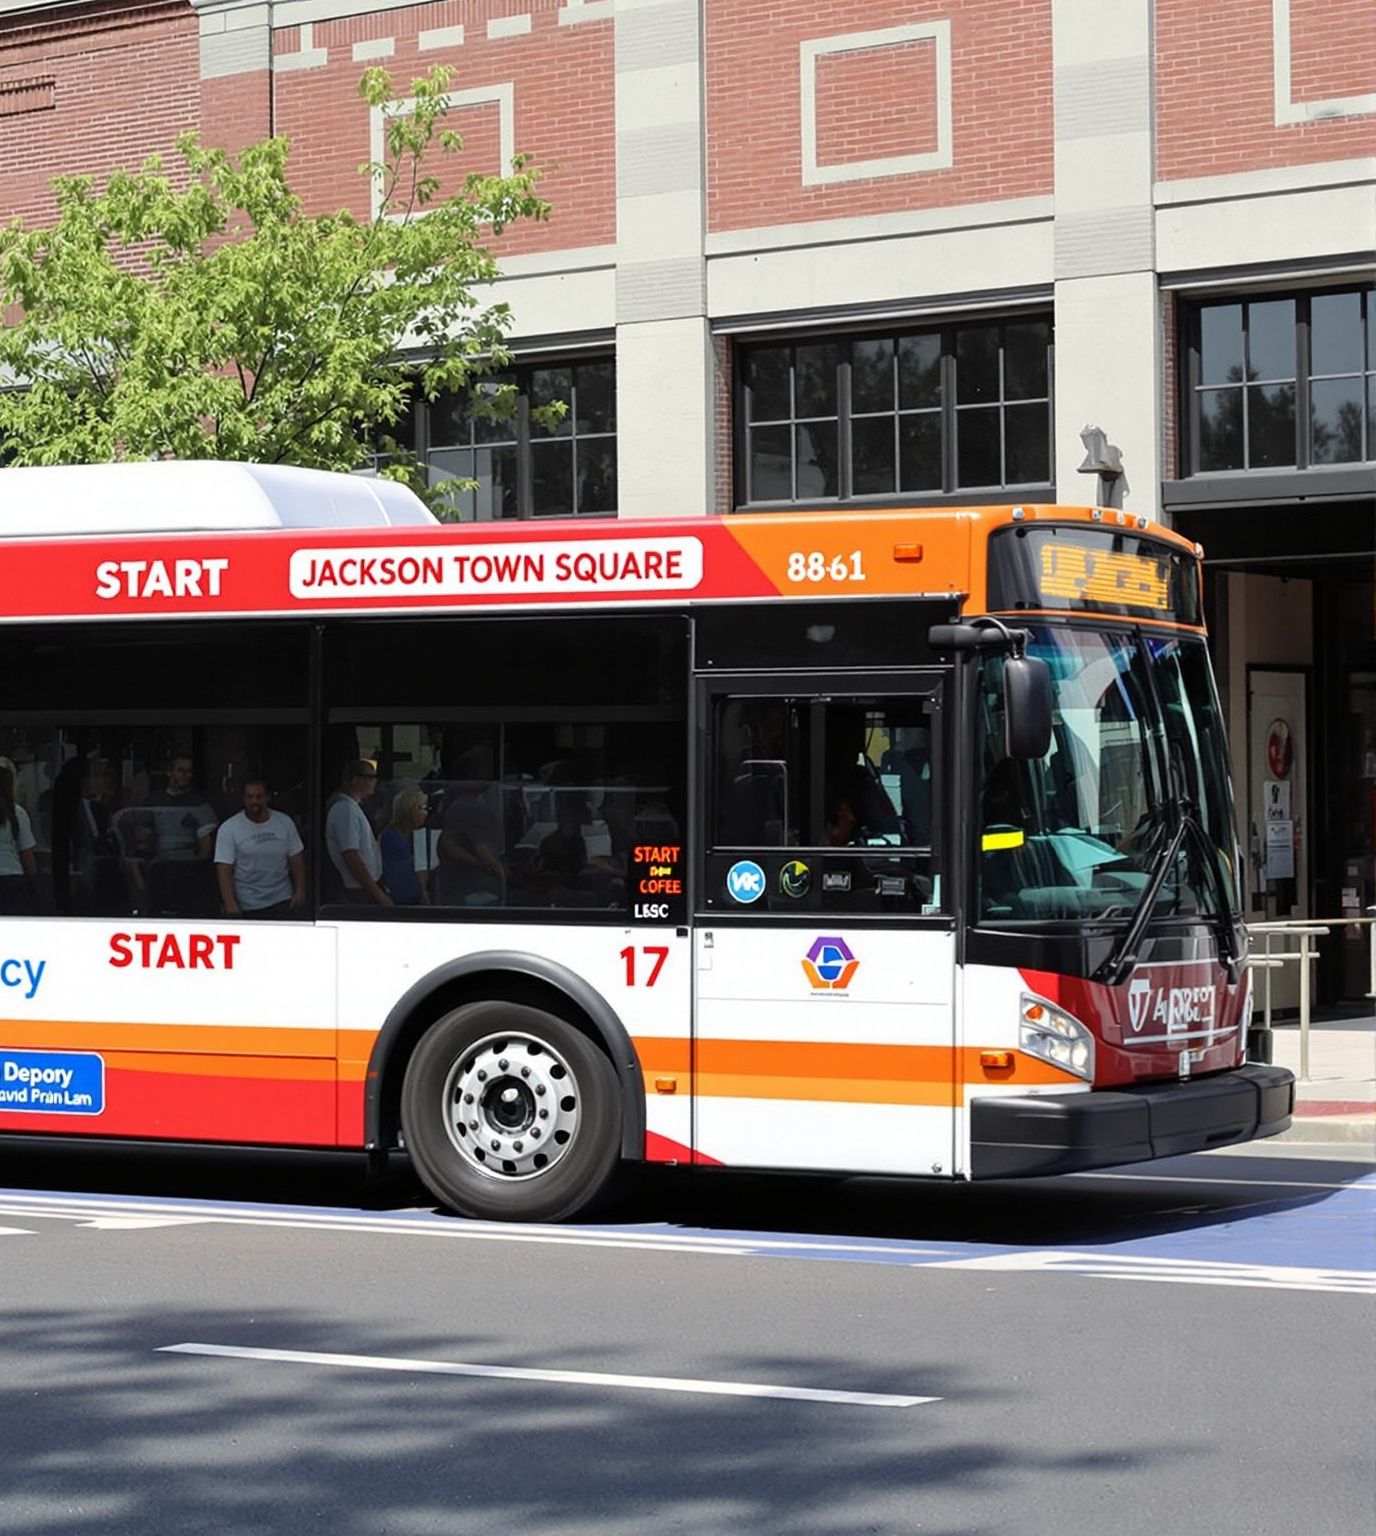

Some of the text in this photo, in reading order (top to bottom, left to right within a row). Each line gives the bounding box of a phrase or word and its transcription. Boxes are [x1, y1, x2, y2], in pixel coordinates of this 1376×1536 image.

[95, 558, 230, 599] START
[302, 550, 683, 588] JACKSON TOWN SQUARE
[634, 846, 680, 863] START
[639, 879, 682, 894] COFEE
[108, 932, 241, 970] START
[619, 945, 670, 988] 17
